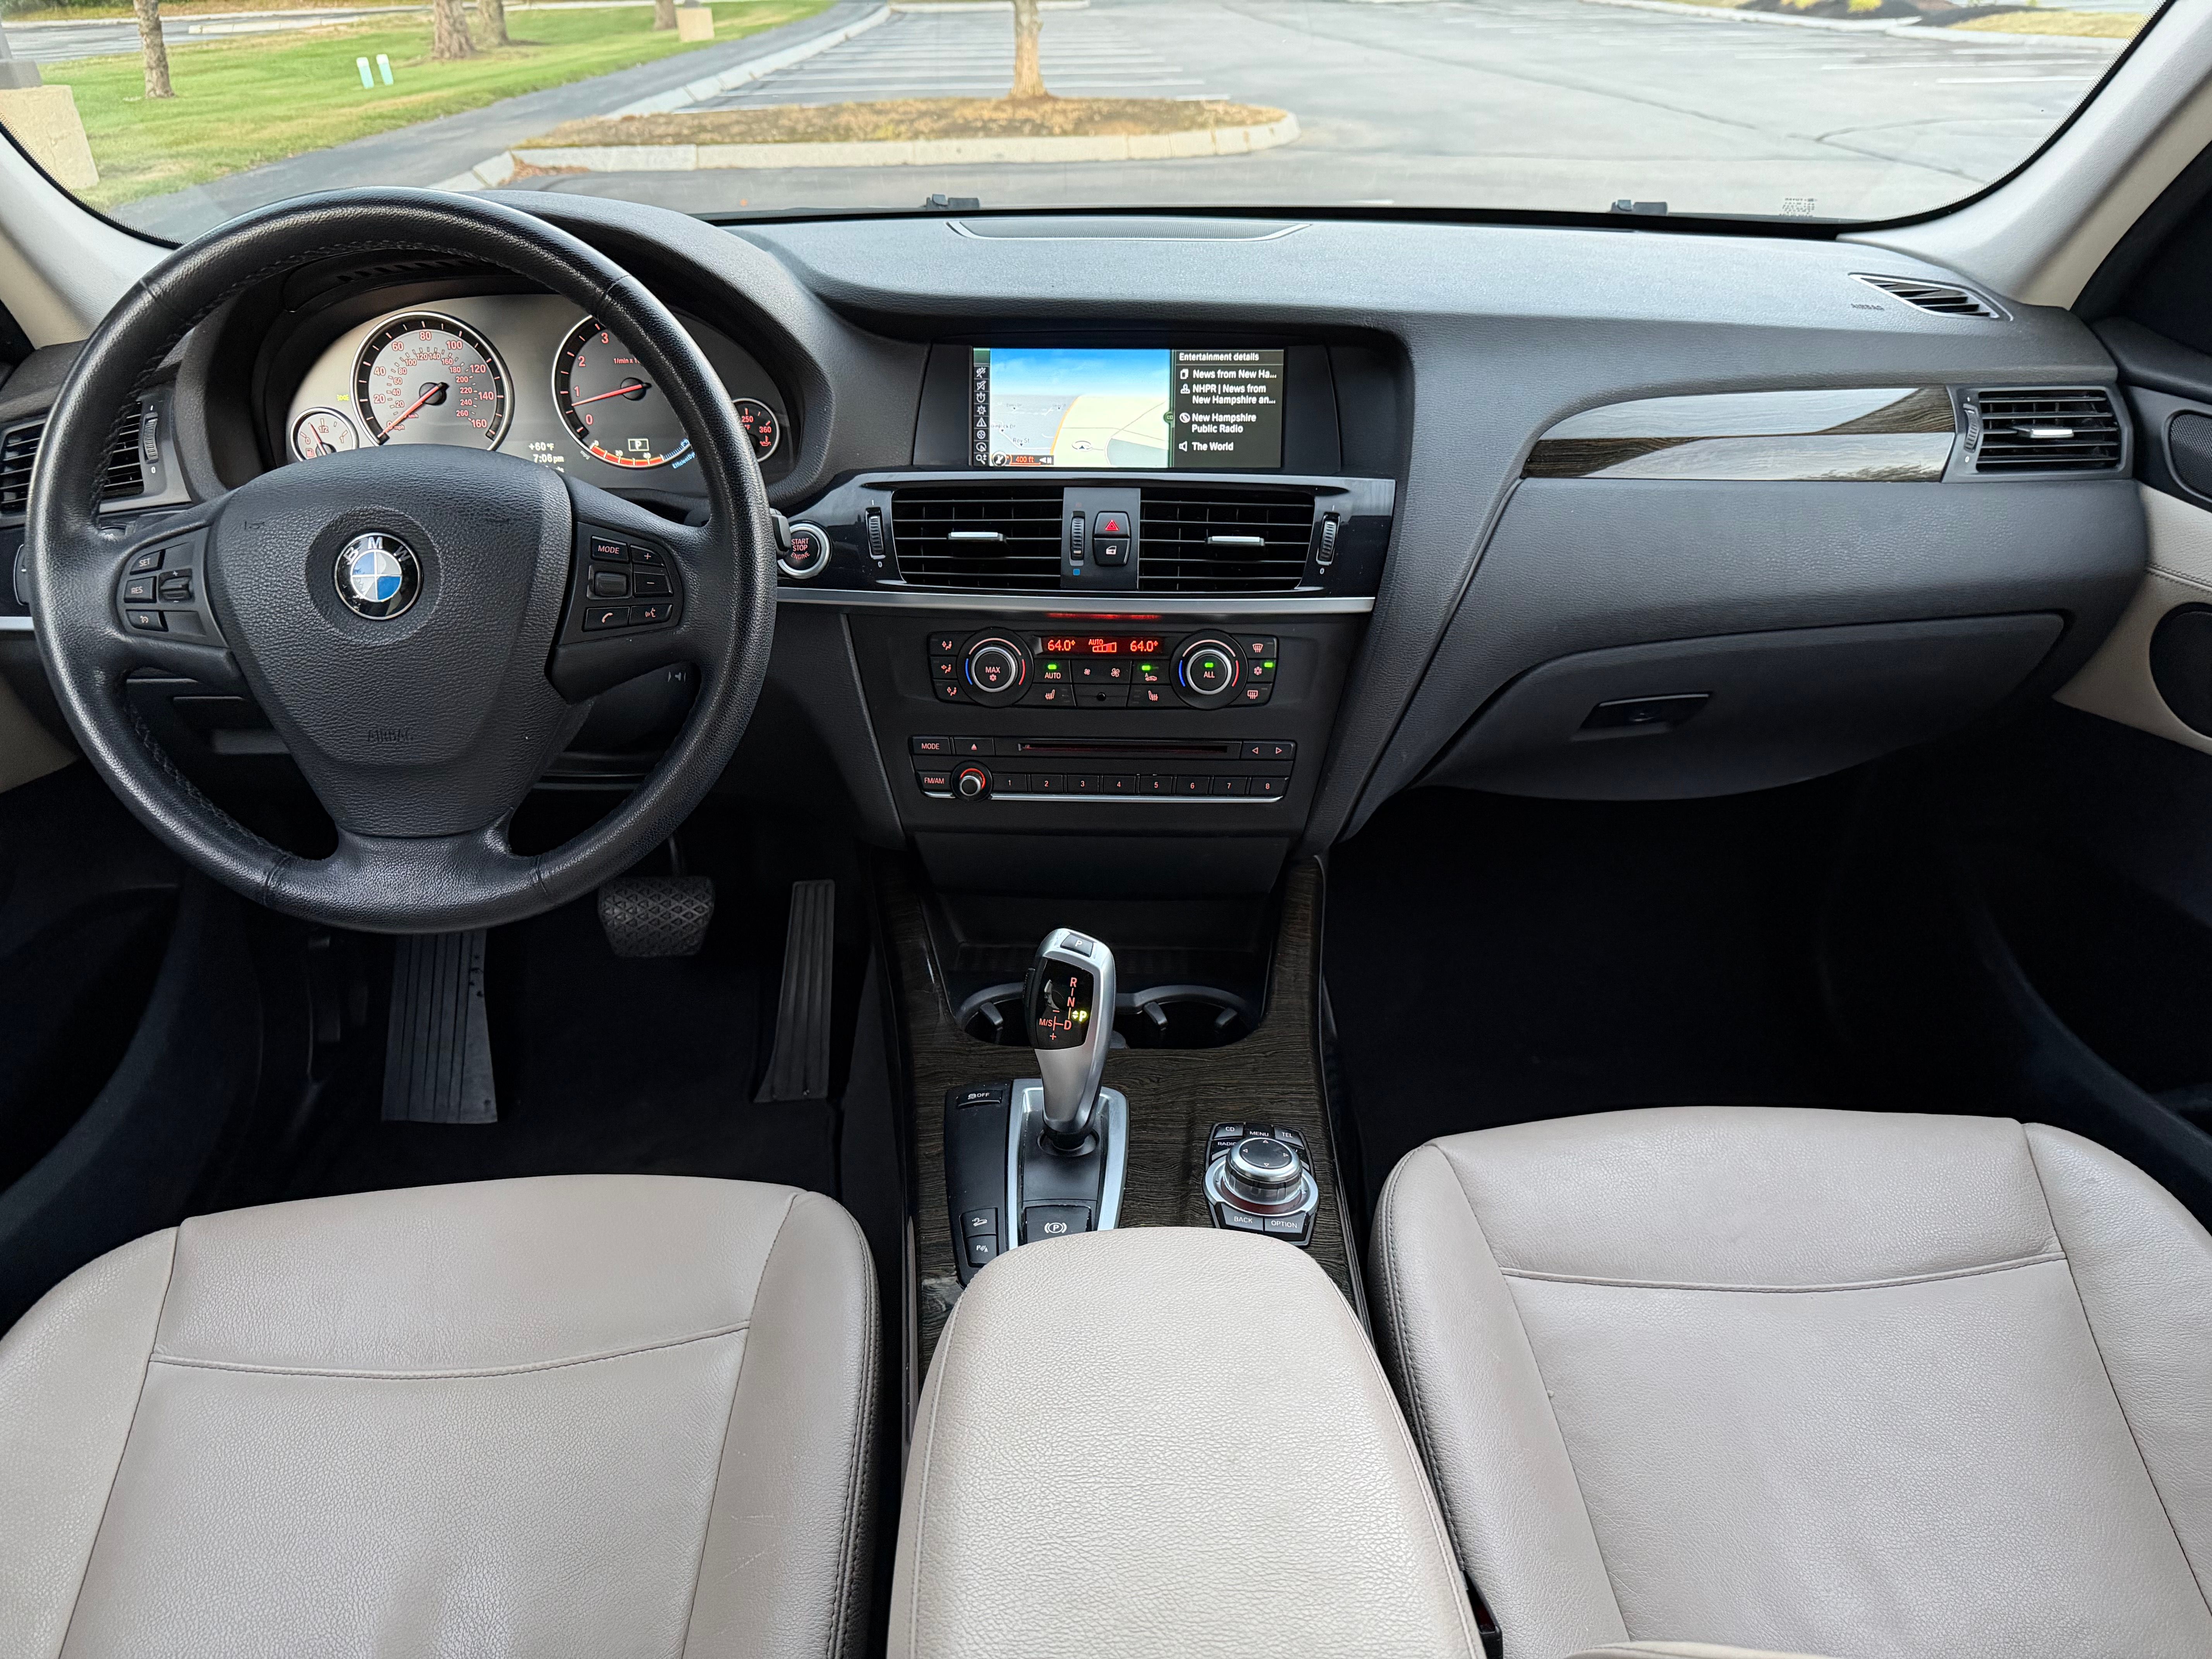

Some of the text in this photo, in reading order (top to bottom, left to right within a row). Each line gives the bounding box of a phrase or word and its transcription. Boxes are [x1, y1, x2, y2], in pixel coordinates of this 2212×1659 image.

[419, 331, 432, 341] 80
[601, 332, 609, 344] 3
[392, 341, 404, 351] 60
[446, 340, 463, 350] 100
[578, 356, 586, 367] 2
[1179, 352, 1259, 361] Entertainment details
[374, 366, 386, 376] 40
[470, 364, 486, 373] 120
[1193, 369, 1277, 378] News from New Ha...
[574, 386, 579, 397] 1
[1192, 384, 1216, 393] NHPR
[1223, 384, 1245, 393] News
[1247, 383, 1266, 393] from
[374, 394, 386, 404] 20
[478, 391, 494, 400] 140
[1192, 395, 1276, 405] New Hampshire an...
[586, 414, 593, 425] 0
[1192, 413, 1257, 423] New Hampshire
[471, 419, 487, 428] 160
[1192, 424, 1243, 433] Public Radio
[635, 440, 641, 450] P
[1192, 442, 1233, 451] The World
[343, 536, 411, 565] BMW
[598, 545, 620, 554] MODE
[791, 551, 810, 560] ENGINE
[139, 558, 150, 567] SET
[131, 586, 143, 594] RES
[1070, 977, 1077, 988] R
[1067, 996, 1075, 1007] N
[1079, 1010, 1087, 1022] P
[1039, 1018, 1053, 1027] M/S
[1064, 1020, 1072, 1030] D
[1271, 1220, 1298, 1229] OPTION
